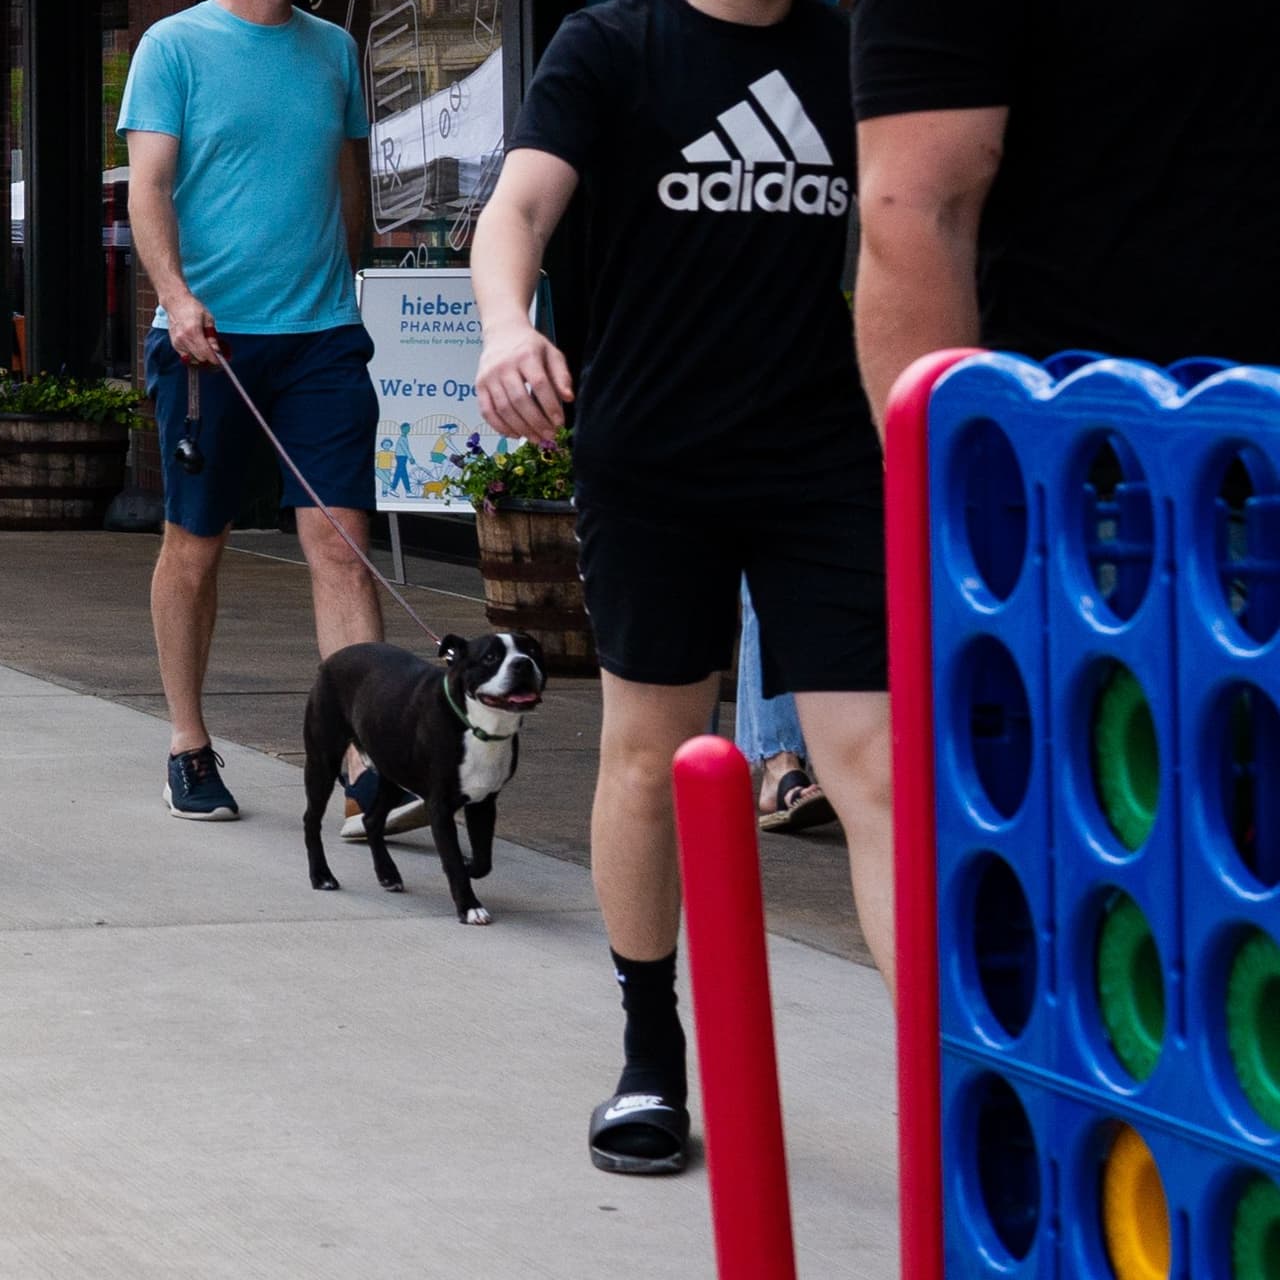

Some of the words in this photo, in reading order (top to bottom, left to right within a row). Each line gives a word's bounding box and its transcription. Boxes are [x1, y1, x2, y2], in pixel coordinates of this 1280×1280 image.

[657, 159, 849, 217] adidas
[401, 294, 478, 315] hieber
[379, 378, 437, 397] We're
